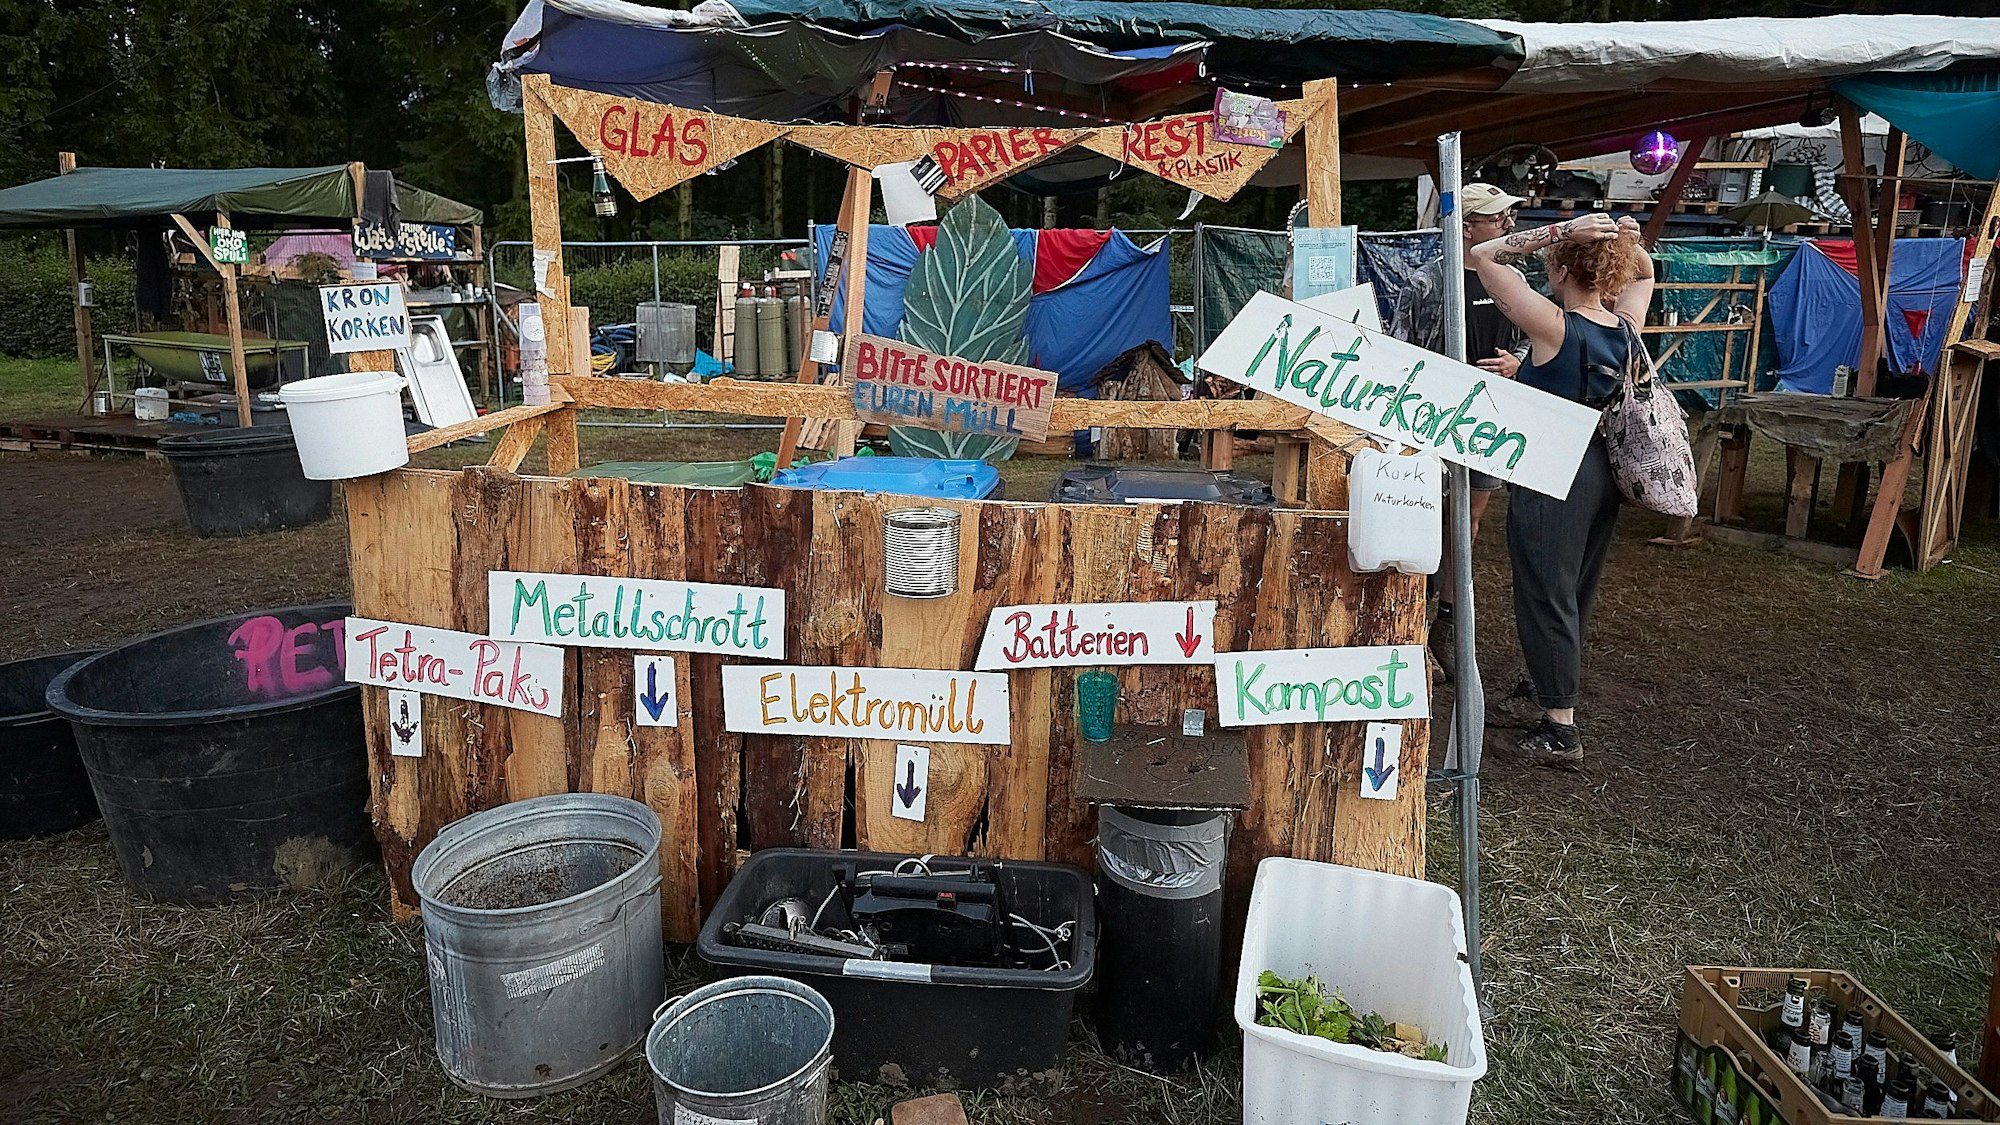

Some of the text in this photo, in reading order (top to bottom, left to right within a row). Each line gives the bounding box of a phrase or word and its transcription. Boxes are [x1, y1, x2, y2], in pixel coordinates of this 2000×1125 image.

[600, 105, 708, 166] GLAS
[933, 127, 1065, 187] PAPIER
[1122, 114, 1215, 164] REST
[1157, 151, 1243, 179] & PLASTIK
[354, 222, 446, 256] Wassrstelle
[327, 286, 389, 312] KRON
[328, 315, 404, 343] KORKEN
[854, 381, 933, 418] EUREN
[856, 341, 928, 387] BITTE
[932, 358, 1048, 409] SORTIERT
[1245, 313, 1528, 471] Naturkorken
[1376, 457, 1426, 484] Kork
[1373, 492, 1436, 512] Naturkorken
[509, 577, 770, 650] Metallschrott
[1002, 608, 1149, 663] Batterien
[227, 616, 345, 692] PET
[759, 670, 984, 734] Elektromüll
[1235, 649, 1414, 721] Kompost
